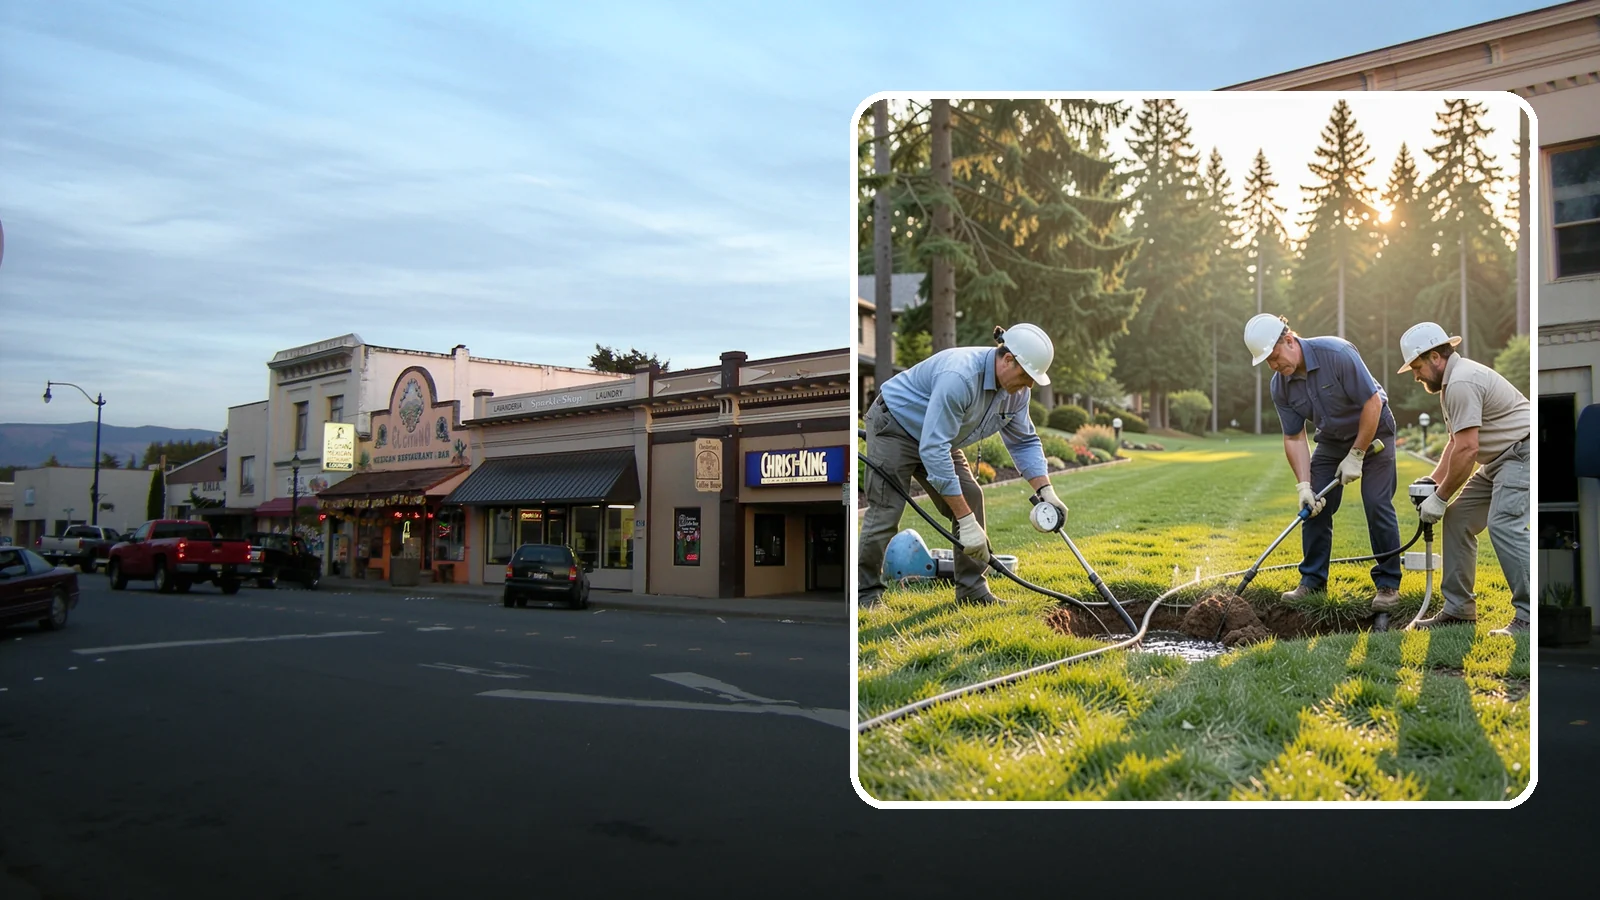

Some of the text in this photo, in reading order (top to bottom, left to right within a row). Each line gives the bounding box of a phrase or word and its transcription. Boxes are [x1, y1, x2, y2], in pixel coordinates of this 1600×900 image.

[493, 389, 623, 412] LAVANDERIA Sparkle Shop LAUNDRY
[373, 454, 396, 464] MEXICAN
[397, 451, 433, 462] RESTAURANT
[438, 450, 450, 459] BAR
[761, 450, 827, 478] CHRIST KING
